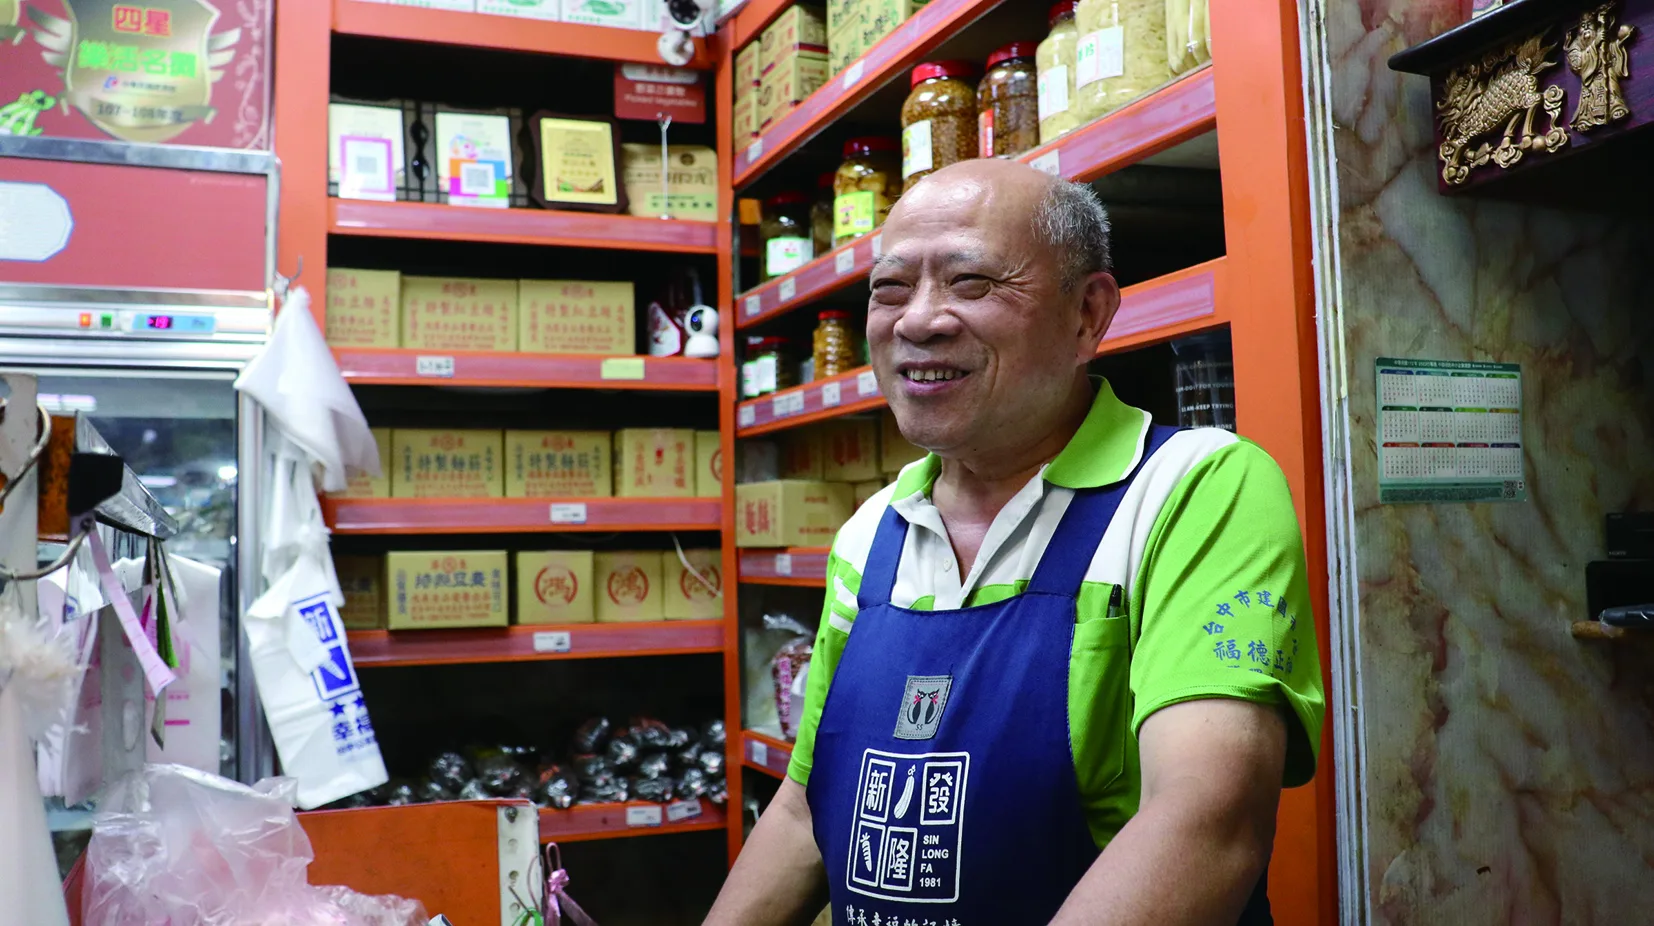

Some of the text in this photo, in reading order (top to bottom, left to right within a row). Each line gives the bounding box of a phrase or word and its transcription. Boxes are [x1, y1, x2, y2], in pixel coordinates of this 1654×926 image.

[112, 4, 171, 37] 四星
[866, 769, 889, 812] 新
[928, 771, 953, 814] 發
[922, 834, 940, 845] SIN
[886, 837, 910, 880] 隆
[921, 848, 949, 859] LONG
[920, 863, 933, 873] FA
[919, 876, 942, 888] 1981
